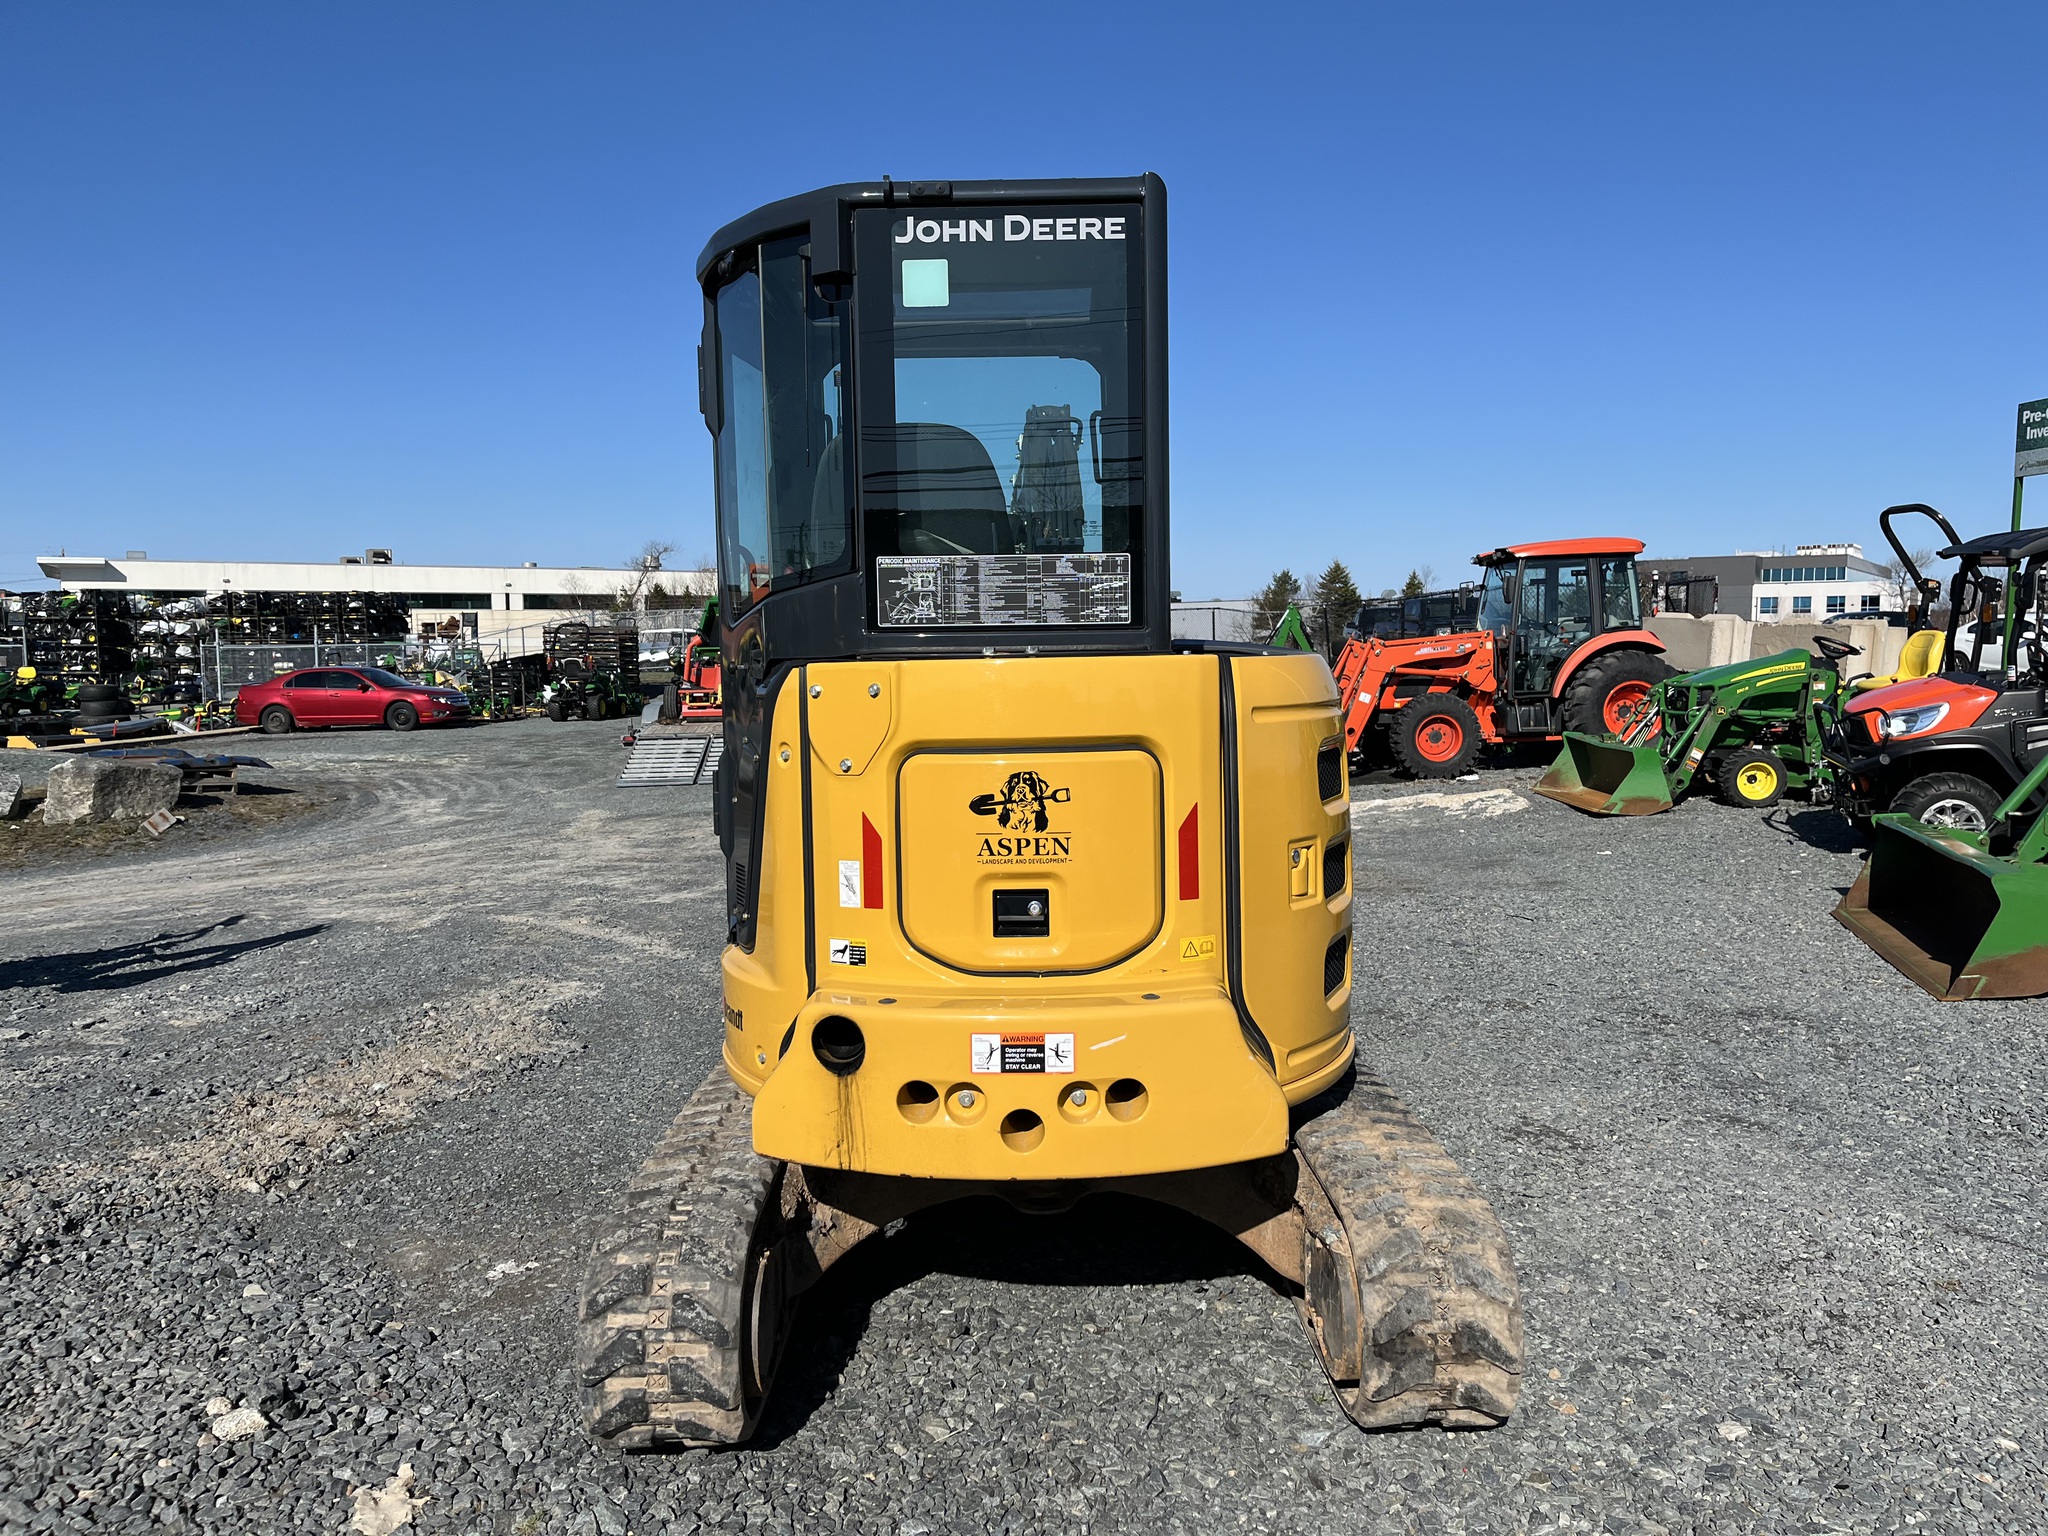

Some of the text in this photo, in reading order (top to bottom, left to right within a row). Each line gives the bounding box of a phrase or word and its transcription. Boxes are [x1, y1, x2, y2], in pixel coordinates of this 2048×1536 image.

[895, 214, 1126, 244] JOHN DEERE
[1784, 664, 1803, 672] DEERE
[977, 837, 1071, 857] ASPEN
